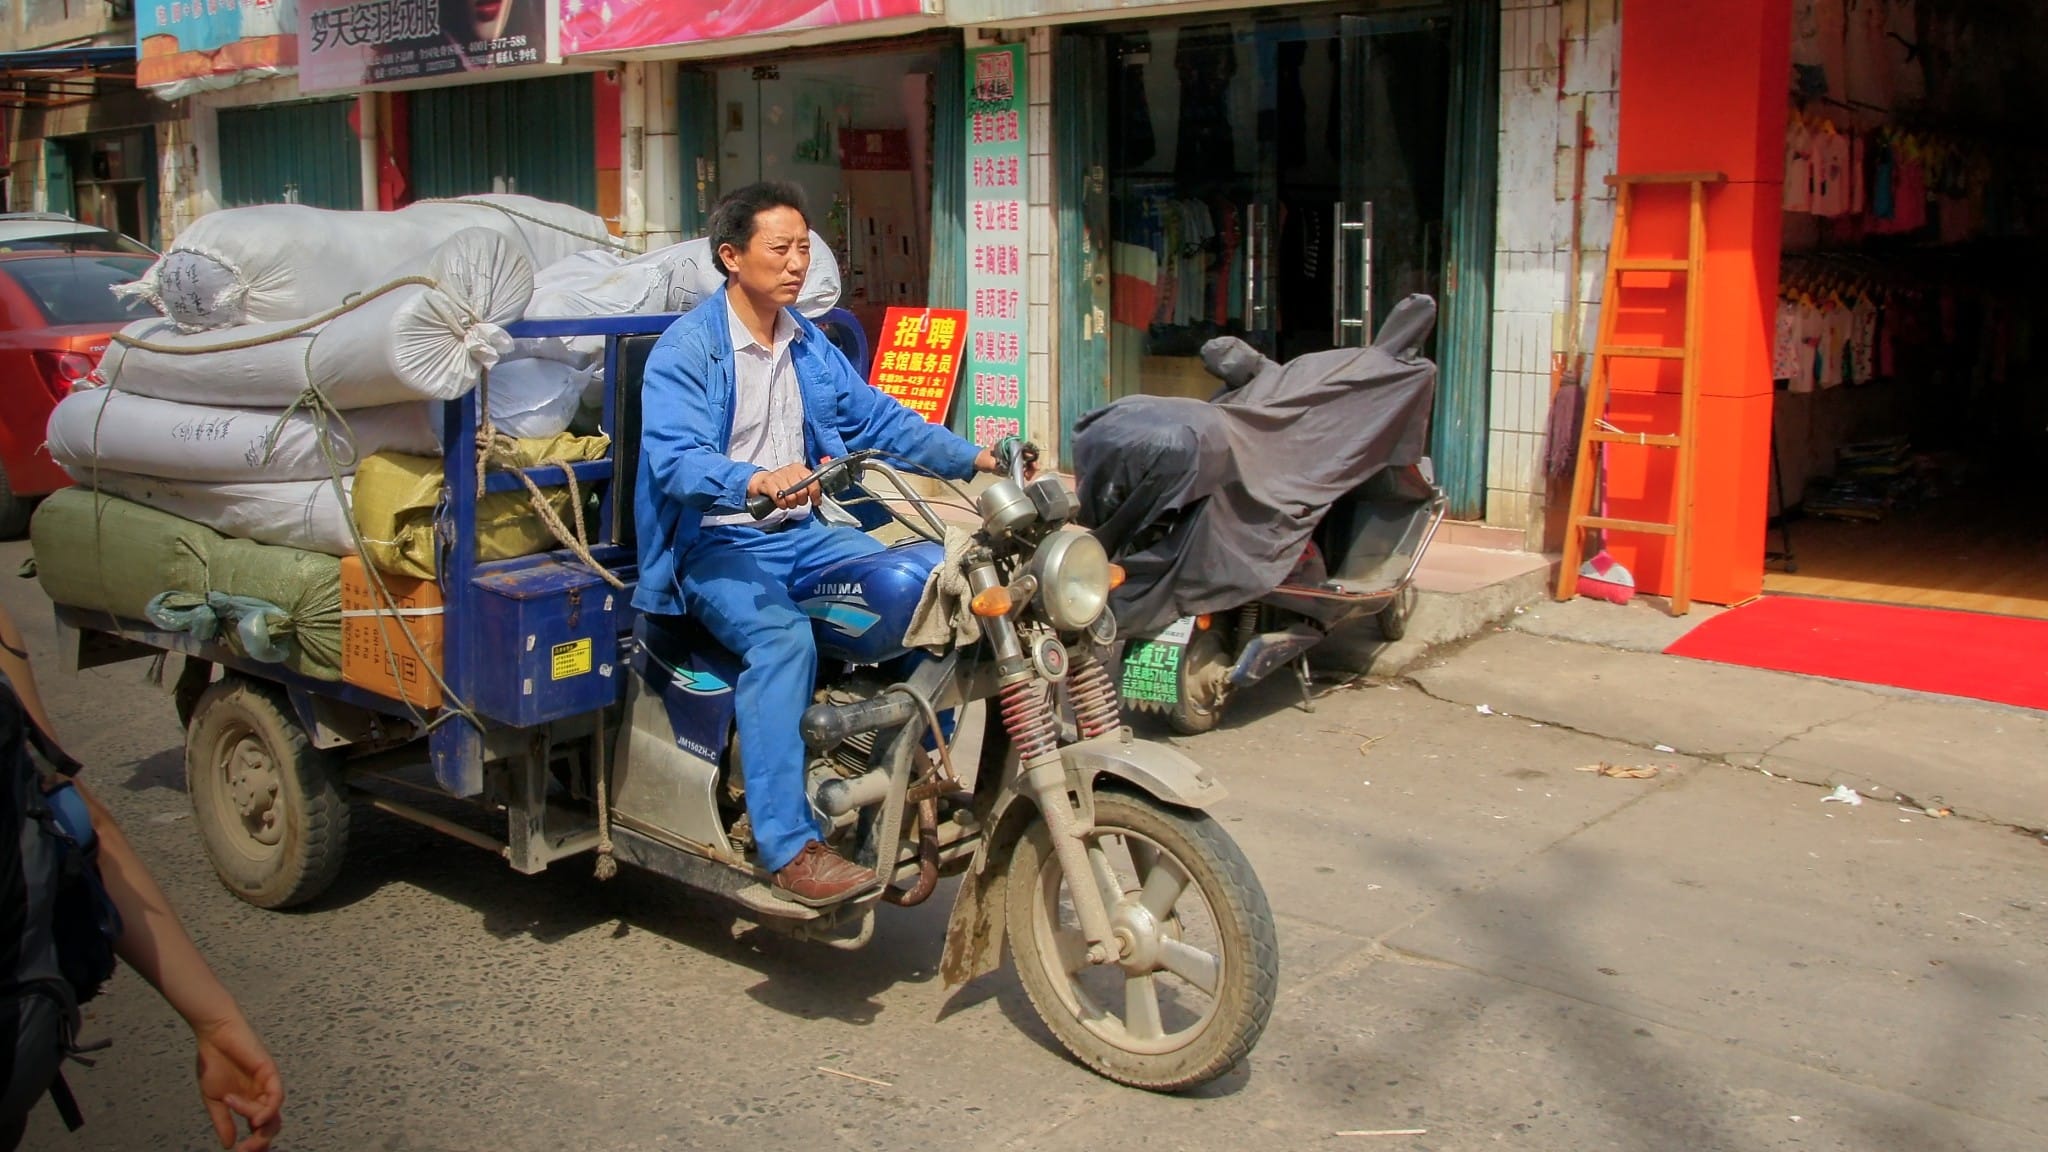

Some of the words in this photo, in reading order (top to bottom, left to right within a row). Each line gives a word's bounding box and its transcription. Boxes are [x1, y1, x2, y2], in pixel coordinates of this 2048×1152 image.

[311, 0, 439, 52] 梦天姿羽绒服
[975, 287, 1018, 319] 肩颈理疗
[893, 315, 957, 350] 招聘
[974, 331, 1019, 363] 卵巢保养
[880, 351, 953, 374] 宾馆服务员
[813, 583, 863, 595] JINMA
[677, 735, 716, 760] JM150ZH-C
